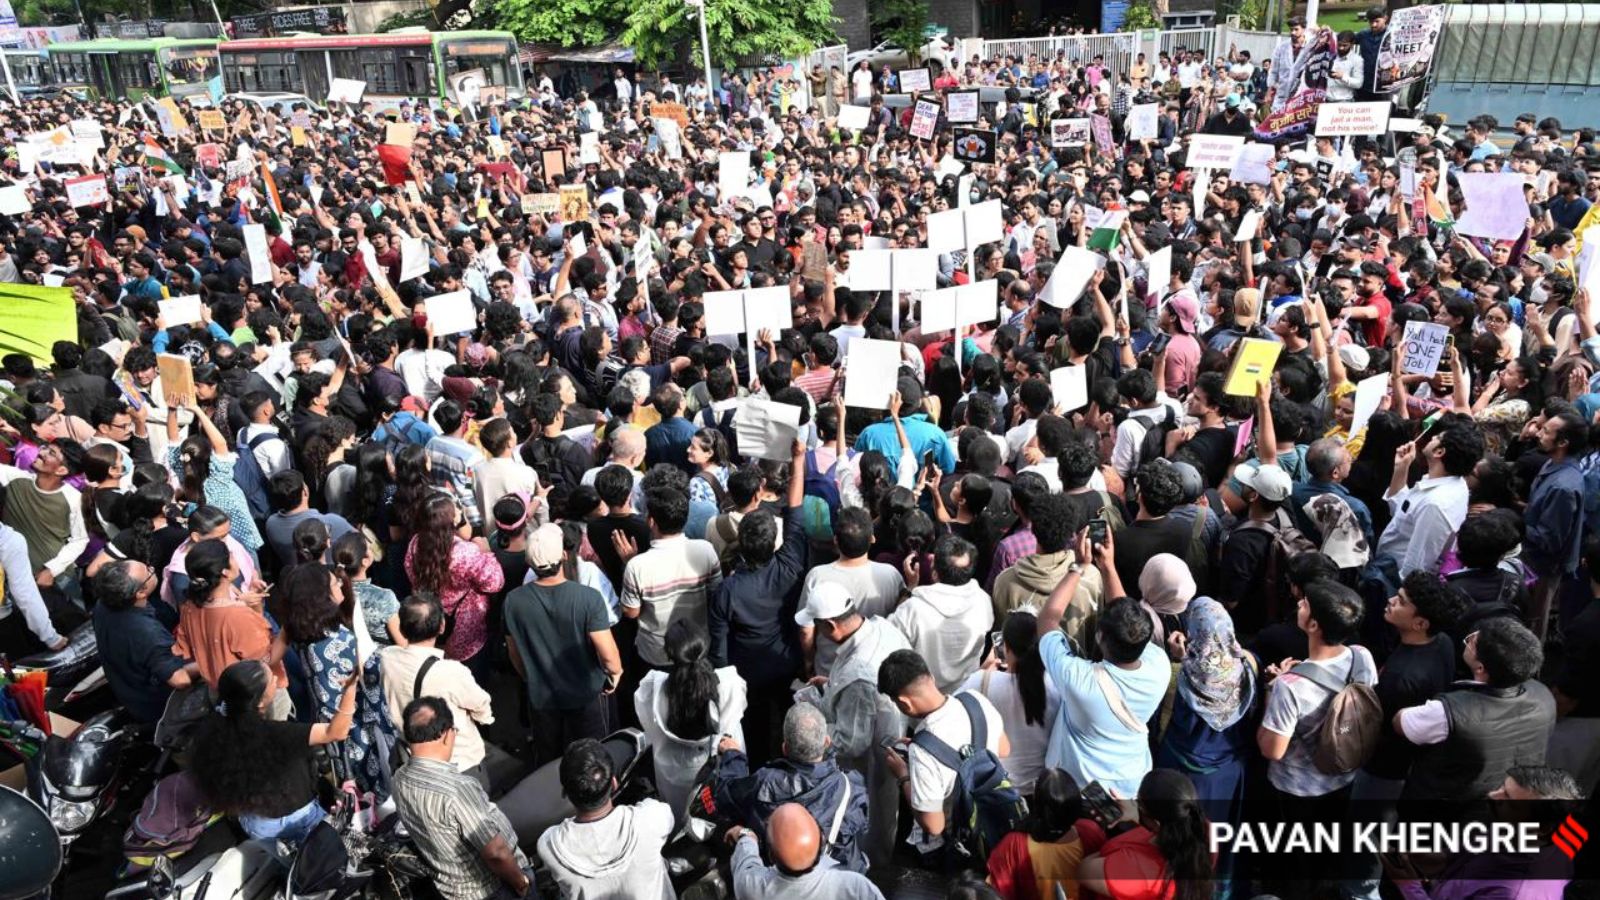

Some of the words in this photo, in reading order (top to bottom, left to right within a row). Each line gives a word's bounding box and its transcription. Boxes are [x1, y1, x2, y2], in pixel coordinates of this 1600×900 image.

[1394, 42, 1424, 54] NEET
[1338, 106, 1353, 114] You
[1330, 115, 1344, 125] jail
[1407, 341, 1436, 359] ONE
[1403, 356, 1431, 374] Job!
